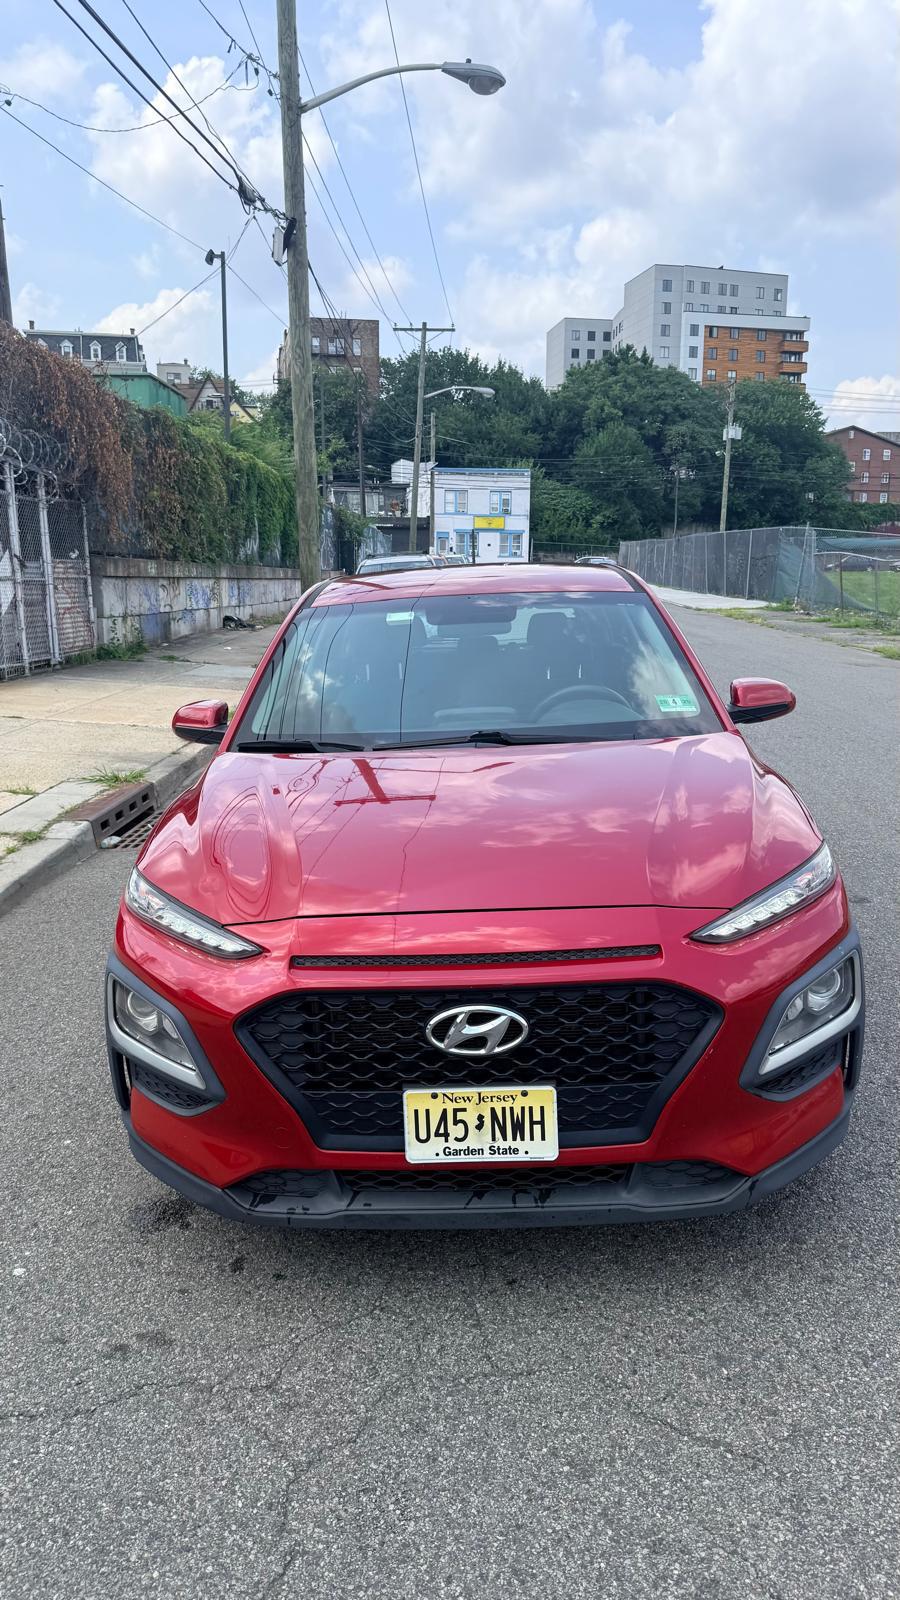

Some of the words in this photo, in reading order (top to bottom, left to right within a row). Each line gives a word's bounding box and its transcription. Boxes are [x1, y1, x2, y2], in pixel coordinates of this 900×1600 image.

[442, 1092, 474, 1104] New
[476, 1091, 518, 1106] Jersey
[414, 1108, 470, 1144] U45
[490, 1106, 546, 1142] NWH
[443, 1146, 484, 1157] Garden
[488, 1145, 519, 1156] State
